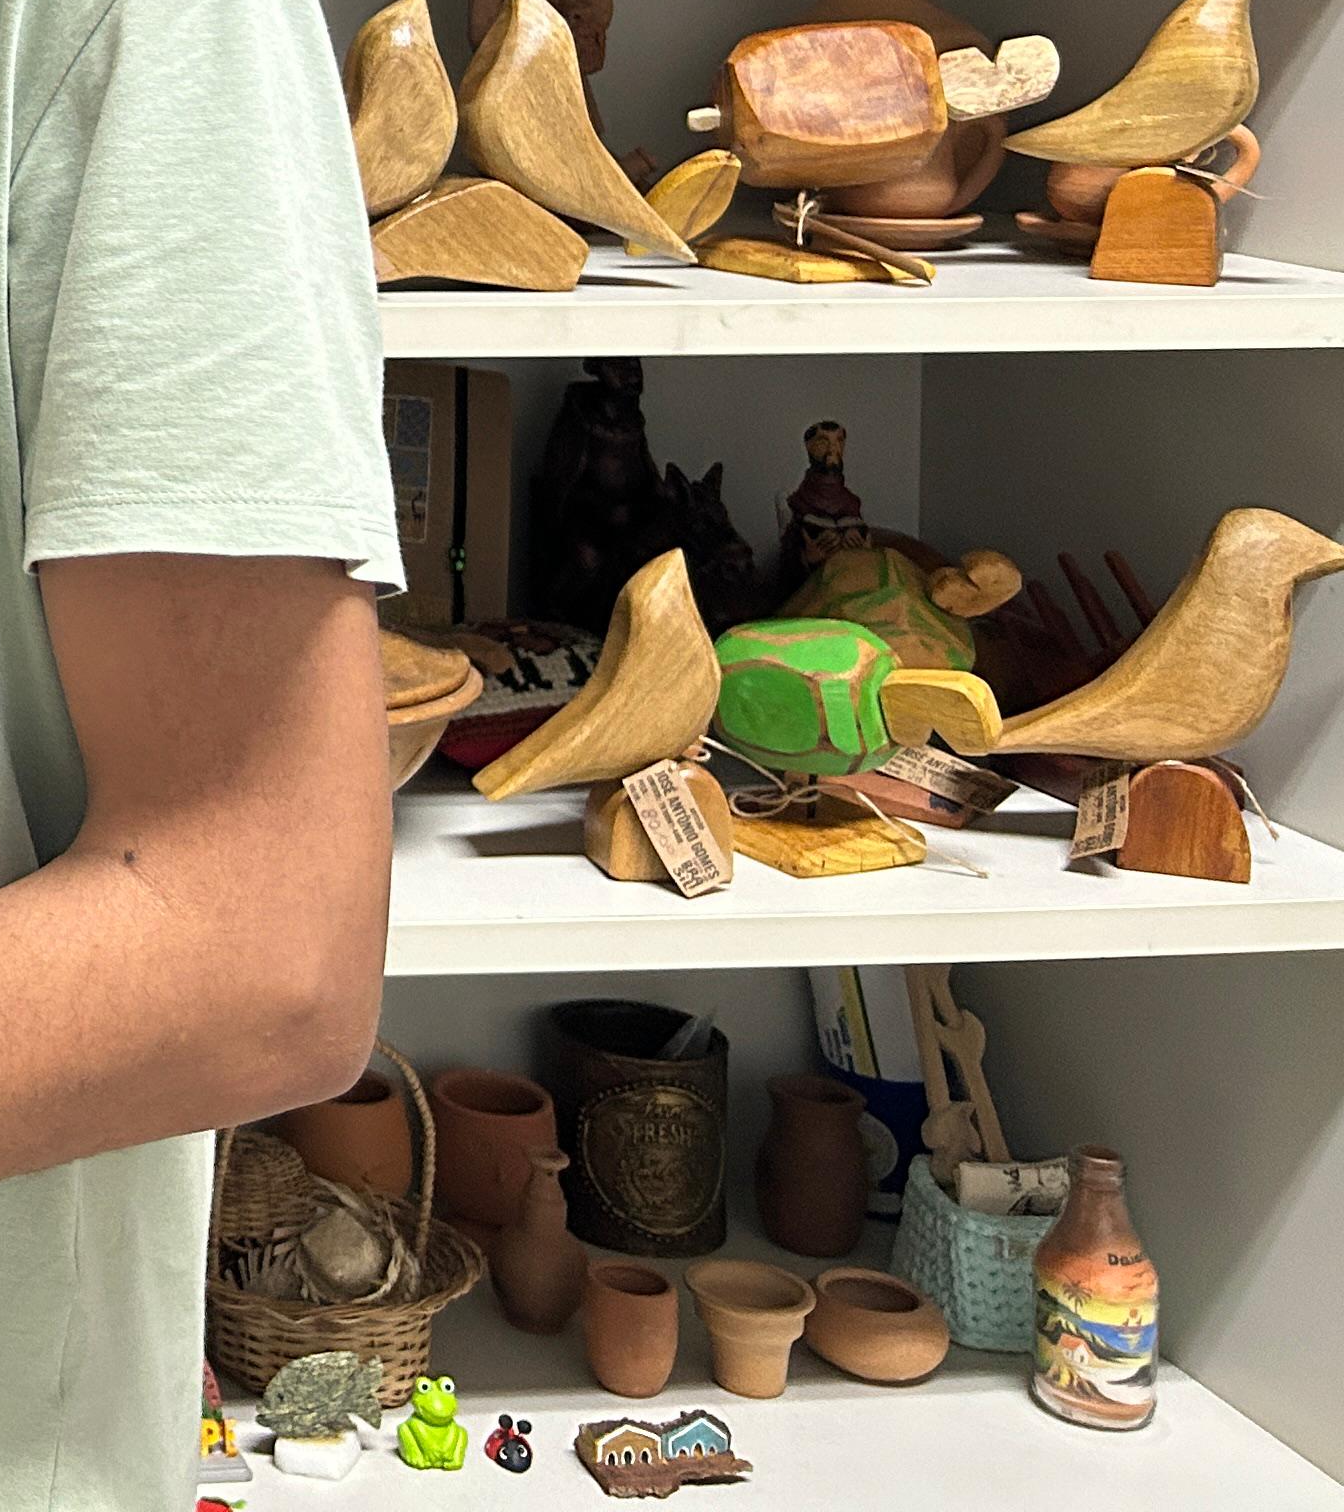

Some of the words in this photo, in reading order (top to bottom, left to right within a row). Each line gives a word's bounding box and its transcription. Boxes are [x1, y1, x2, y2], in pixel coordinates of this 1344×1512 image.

[654, 770, 678, 797] JOSÉ
[668, 796, 699, 842] ANTÔNIO
[692, 842, 720, 879] GOMES
